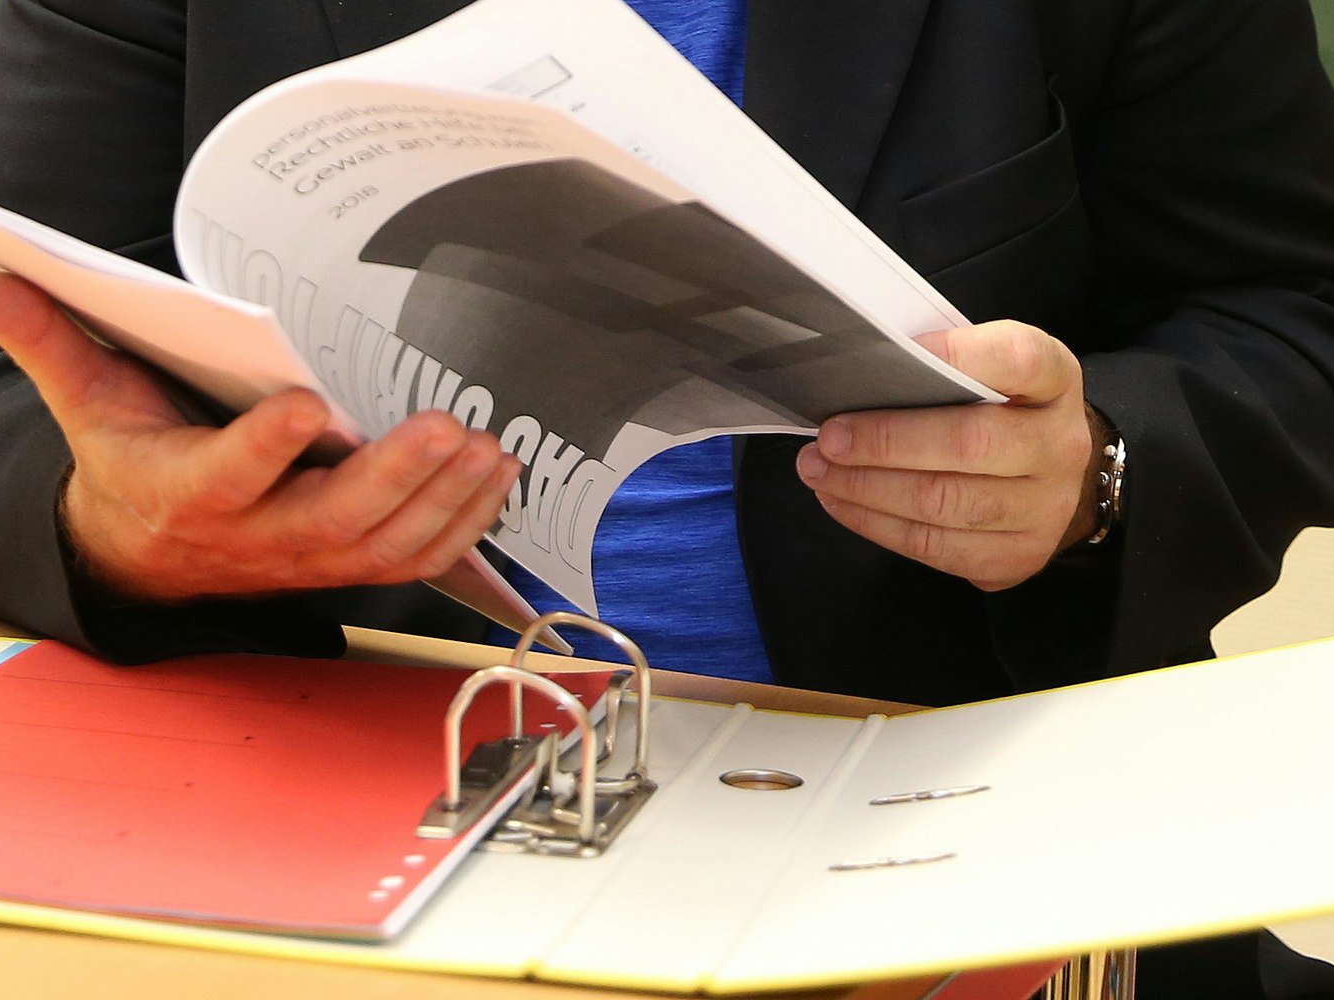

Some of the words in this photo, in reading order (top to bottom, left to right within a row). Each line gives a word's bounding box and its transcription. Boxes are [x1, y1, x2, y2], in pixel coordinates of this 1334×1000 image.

[268, 119, 414, 181] Rechtliche
[294, 143, 392, 195] Gewalt
[395, 136, 435, 150] an
